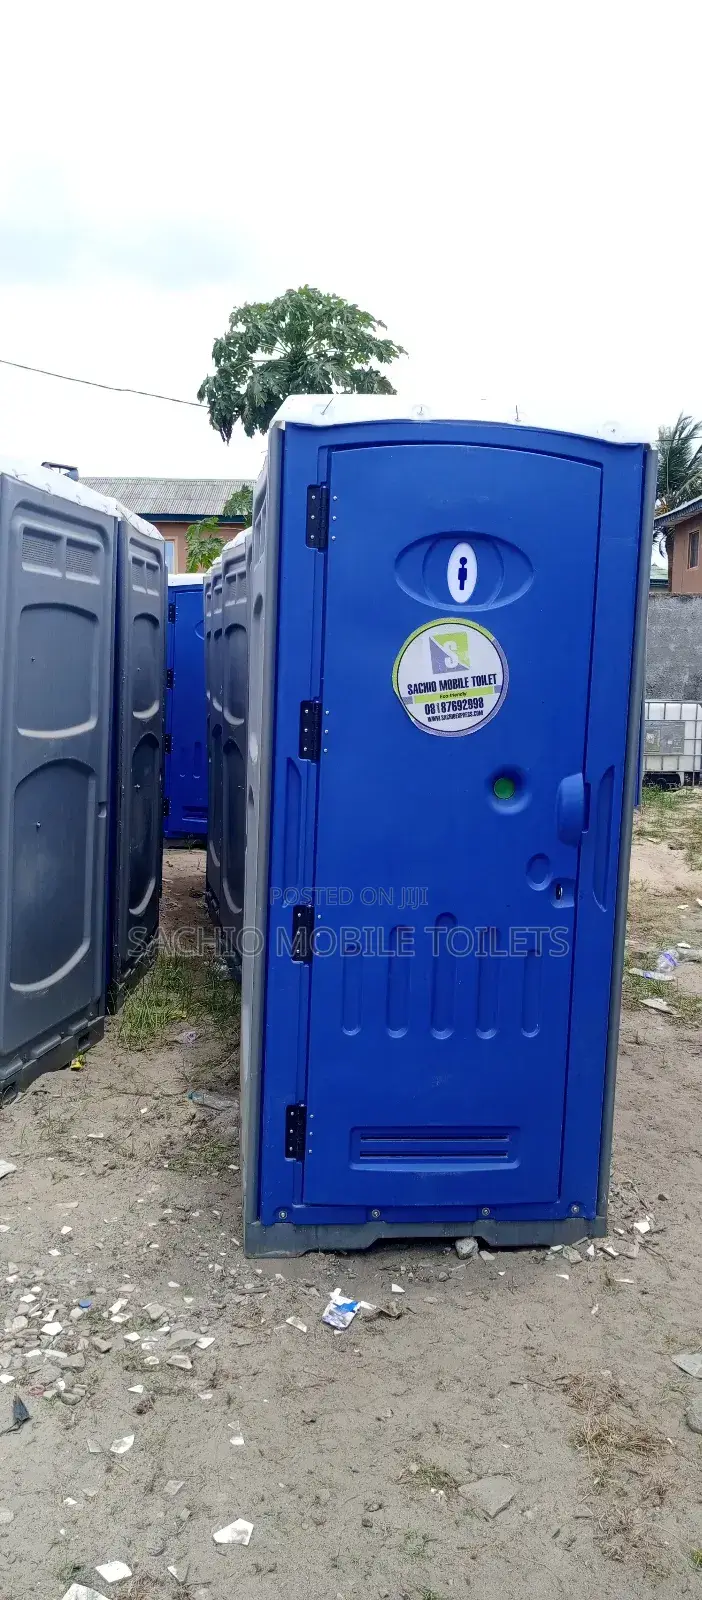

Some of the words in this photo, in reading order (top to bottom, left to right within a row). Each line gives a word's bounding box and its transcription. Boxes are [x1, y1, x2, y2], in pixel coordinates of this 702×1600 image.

[444, 640, 459, 669] S
[407, 681, 437, 695] SACHIO
[439, 676, 469, 691] MOBILE
[471, 673, 497, 687] TOILET
